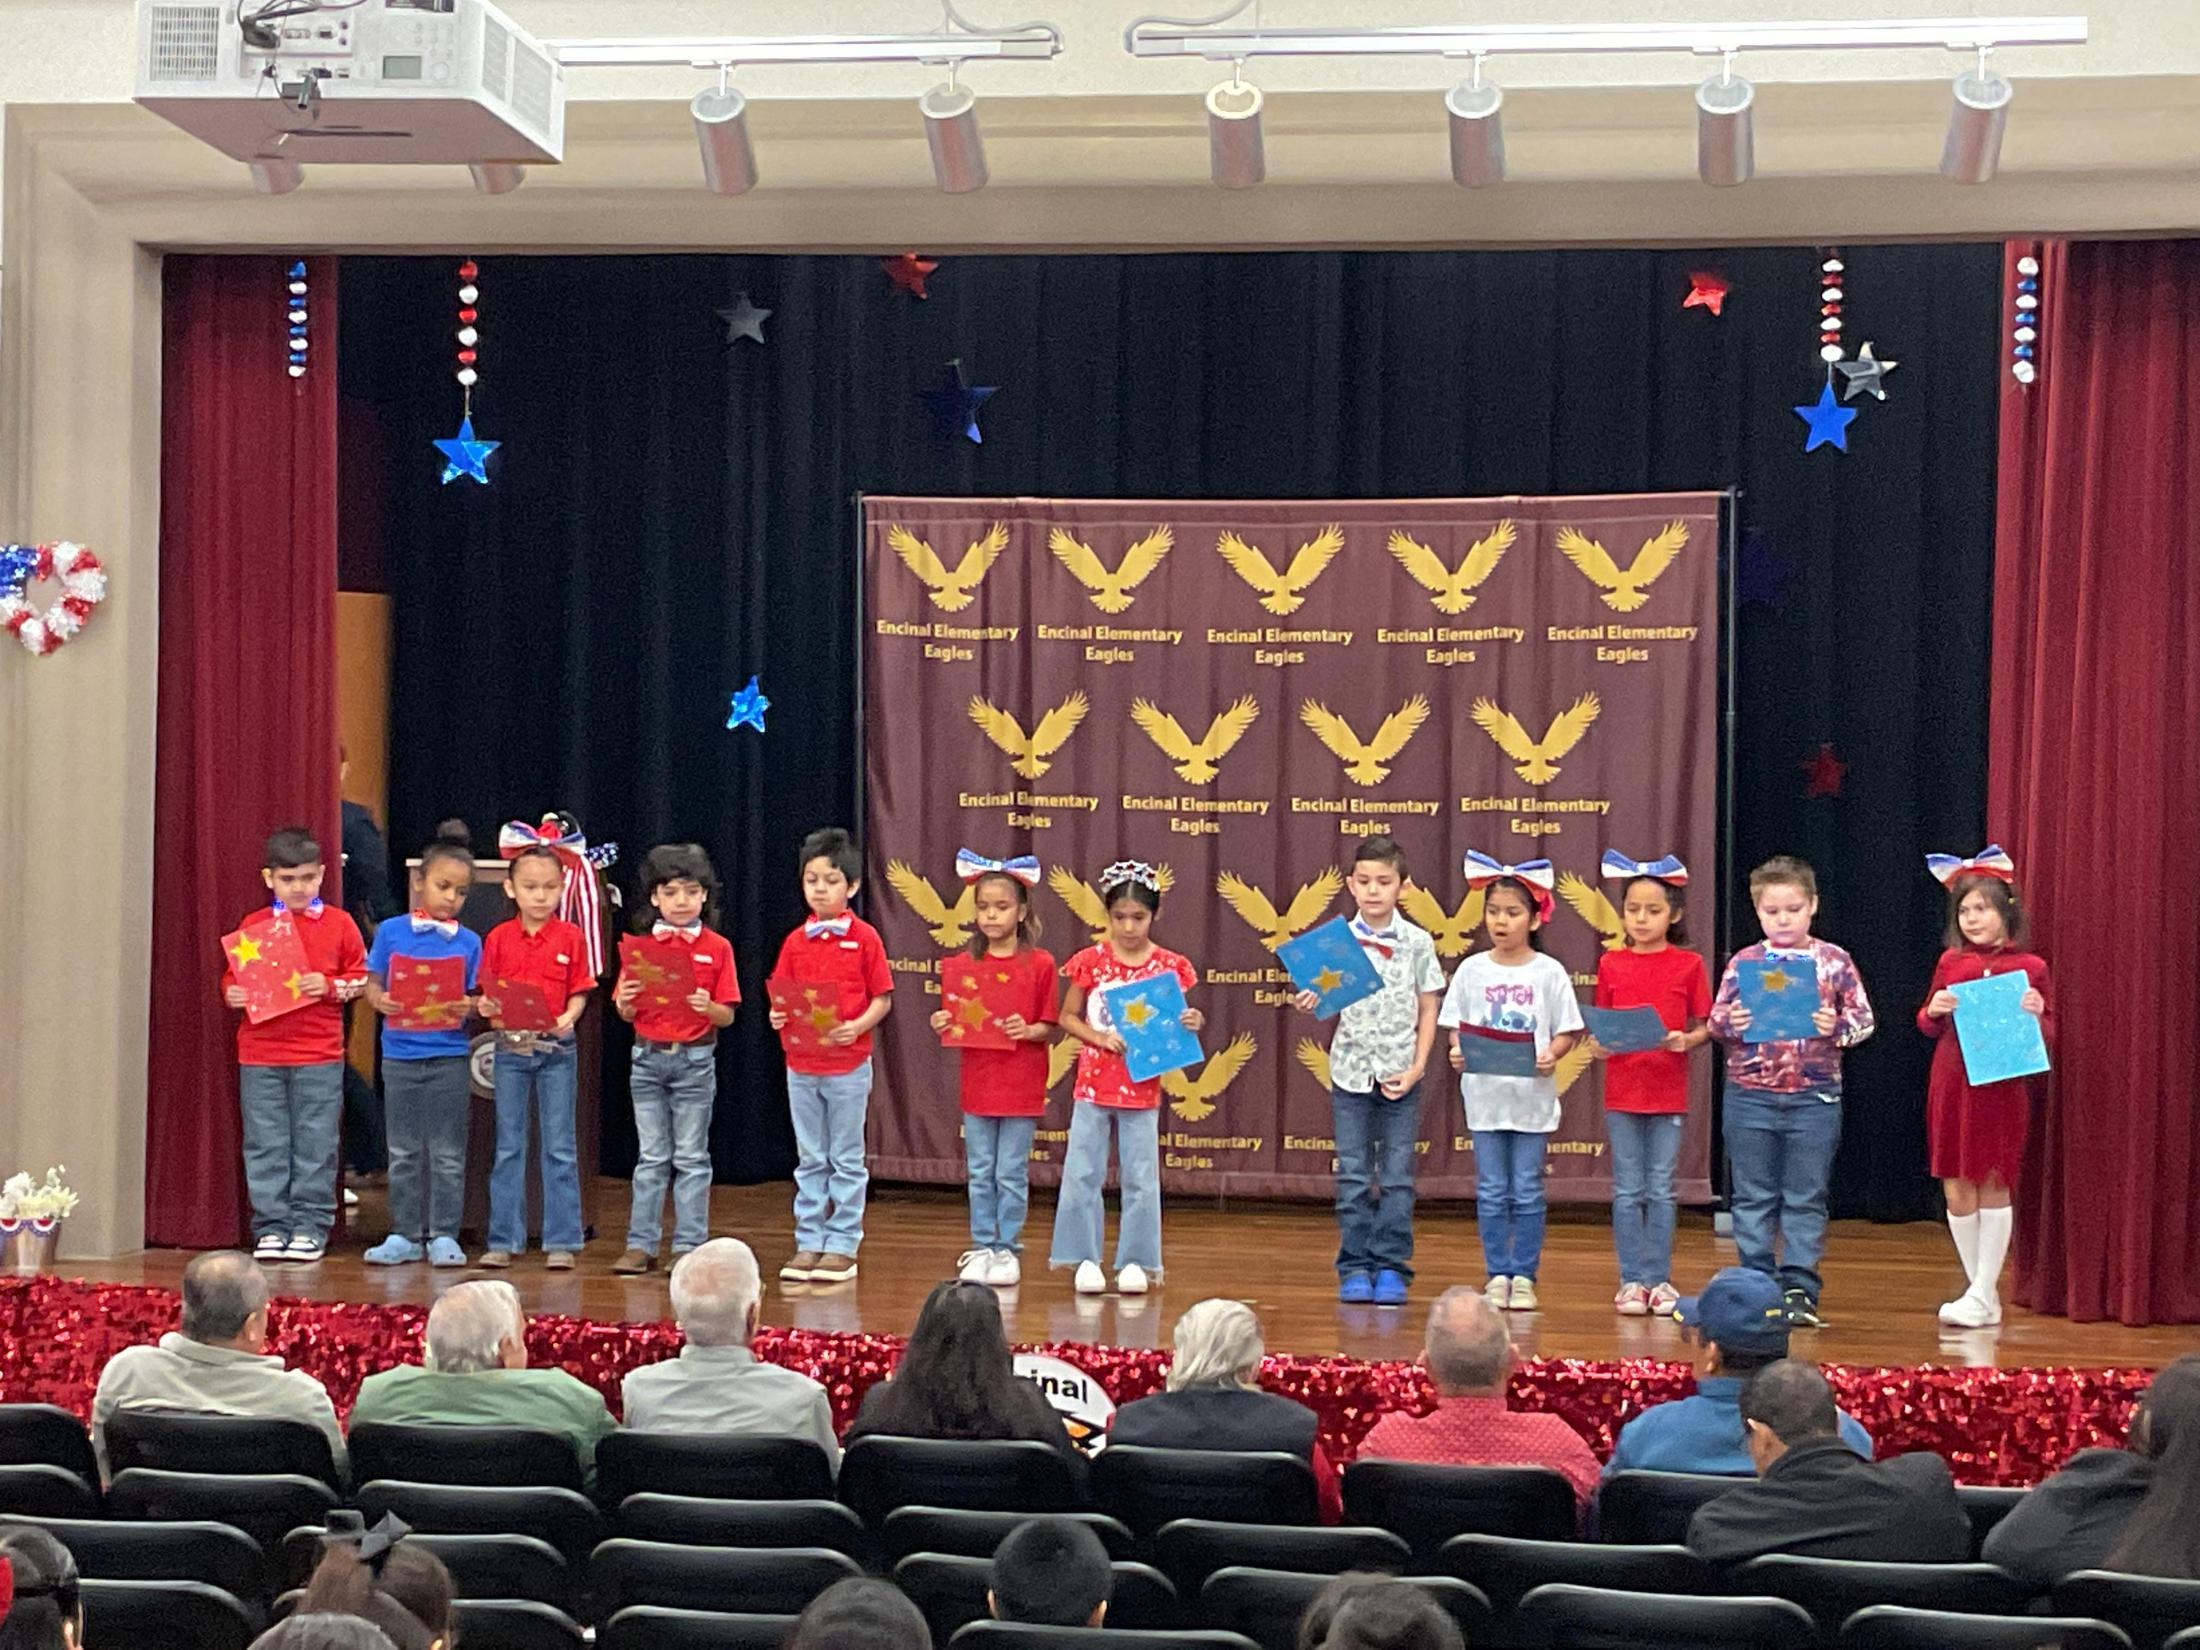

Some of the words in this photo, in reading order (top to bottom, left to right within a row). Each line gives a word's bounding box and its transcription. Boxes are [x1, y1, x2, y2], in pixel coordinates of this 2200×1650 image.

[877, 620, 931, 638] Encinal
[934, 624, 1019, 642] Elementary
[1038, 624, 1093, 641] Encinal
[1096, 625, 1182, 645] Elementary
[1207, 629, 1263, 644] Encinal
[1266, 628, 1353, 645] Elementary
[1377, 628, 1434, 643] Encinal
[1437, 626, 1524, 643] Elementary
[1548, 625, 1604, 641] Encinal
[1607, 625, 1698, 642] Elementary
[924, 645, 973, 662] Eagles
[1086, 647, 1134, 664] Eagles
[1255, 649, 1304, 666] Eagles
[1426, 649, 1476, 666] Eagles
[1597, 647, 1648, 663] Eagles
[959, 792, 1014, 808] Encinal
[1017, 792, 1098, 811] Elementary
[1123, 796, 1178, 812] Encinal
[1182, 797, 1269, 815] Elementary
[1291, 798, 1347, 813] Encinal
[1351, 799, 1439, 816] Elementary
[1461, 797, 1517, 812] Encinal
[1522, 798, 1610, 815] Elementary
[1007, 813, 1051, 829] Eagles
[1171, 818, 1220, 835] Eagles
[1340, 820, 1391, 836] Eagles
[1511, 819, 1561, 836] Eagles
[887, 957, 931, 973] ncinal
[1206, 969, 1262, 983] Encinal
[1255, 989, 1295, 1007] Eagle
[1176, 1134, 1262, 1151] Elementary
[1284, 1135, 1335, 1150] Encina
[1547, 1141, 1603, 1156] entary
[1165, 1153, 1213, 1170] Eagles
